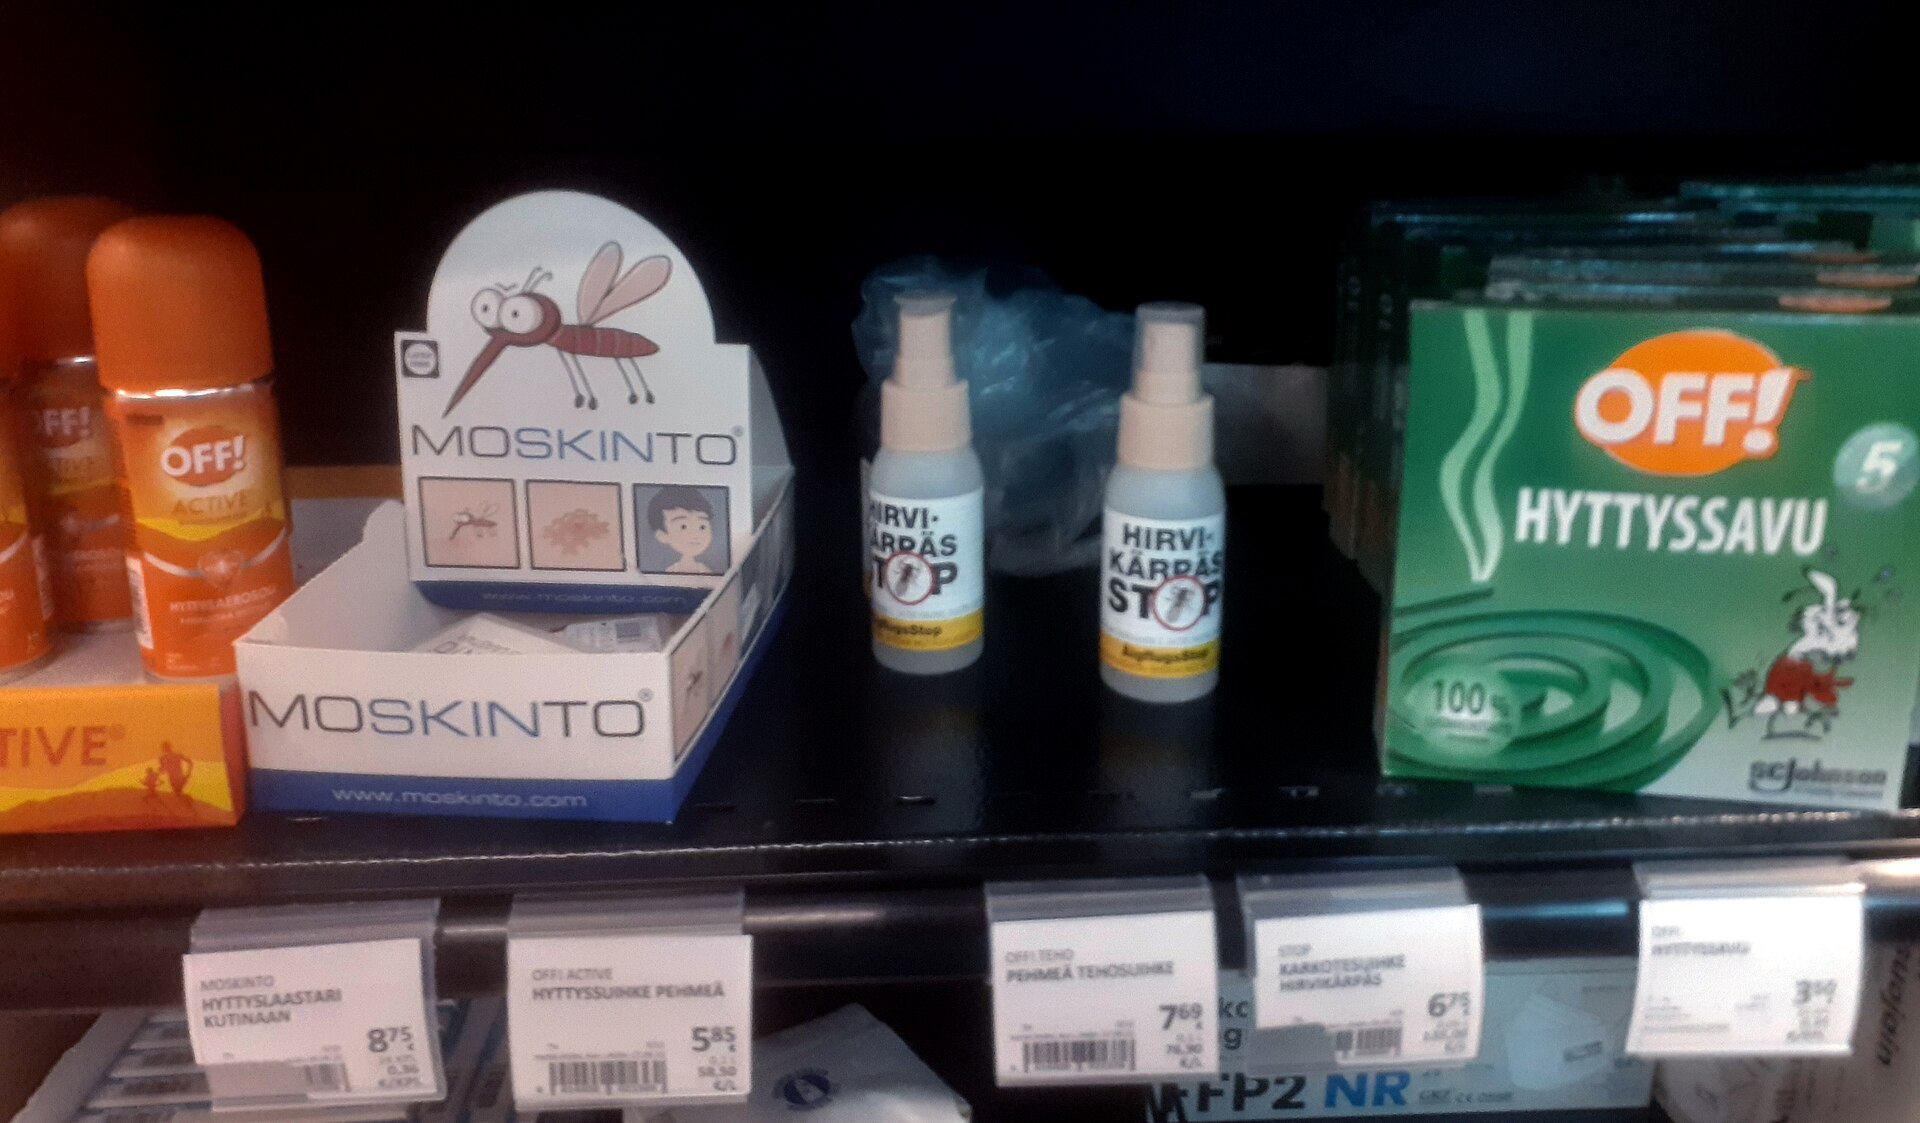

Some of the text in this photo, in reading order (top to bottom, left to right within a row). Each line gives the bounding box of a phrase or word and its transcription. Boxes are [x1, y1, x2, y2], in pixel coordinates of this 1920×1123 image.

[1575, 366, 1797, 456] OFF!
[160, 435, 246, 476] OFF!
[1856, 440, 1901, 494] 5
[1515, 486, 1829, 557] HYTTYSSAVU
[1108, 548, 1224, 581] KÄRPÄS
[248, 690, 646, 738] MOSKINTO
[1433, 679, 1486, 714] 100
[330, 787, 588, 810] www.moskinto.com
[202, 988, 342, 1012] HYTTYSLAASTARI
[204, 1011, 291, 1028] KUTINAAN
[1324, 1071, 1410, 1109] NR
